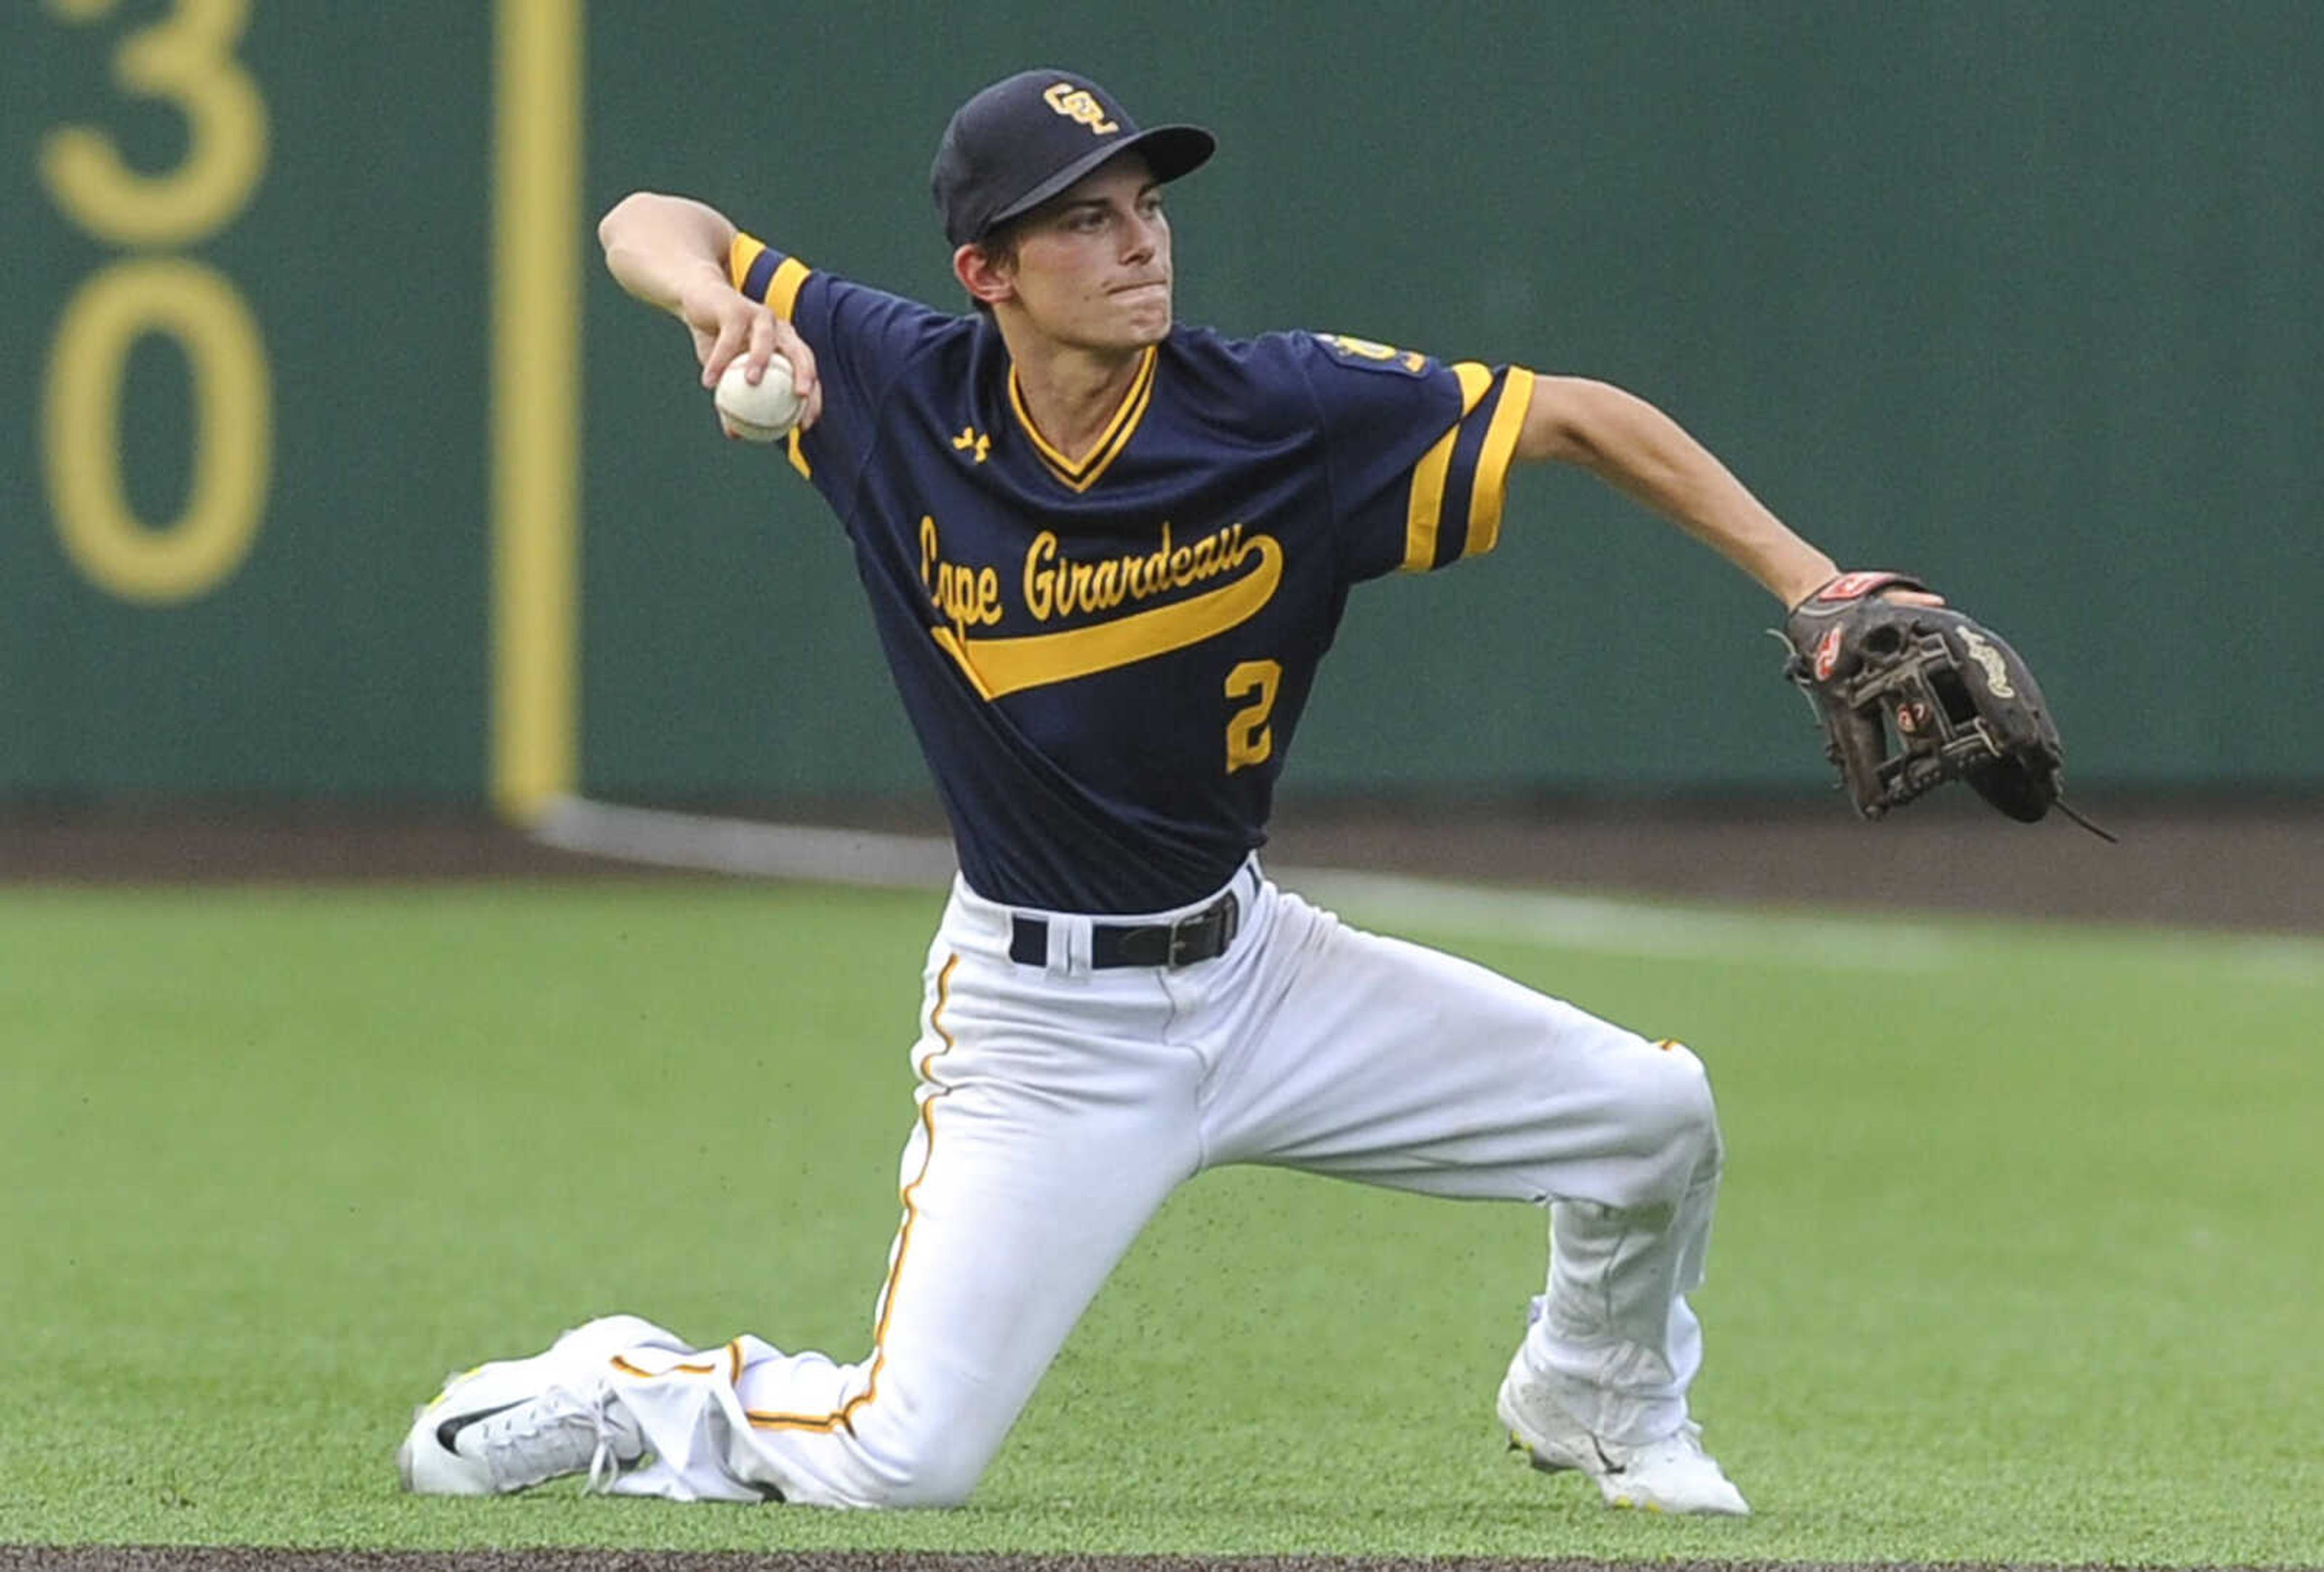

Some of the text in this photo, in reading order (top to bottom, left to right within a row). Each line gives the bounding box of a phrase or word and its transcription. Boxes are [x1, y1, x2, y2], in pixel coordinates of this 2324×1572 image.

[920, 515, 1244, 645] Cape Girardeau
[1224, 659, 1282, 774] 2
